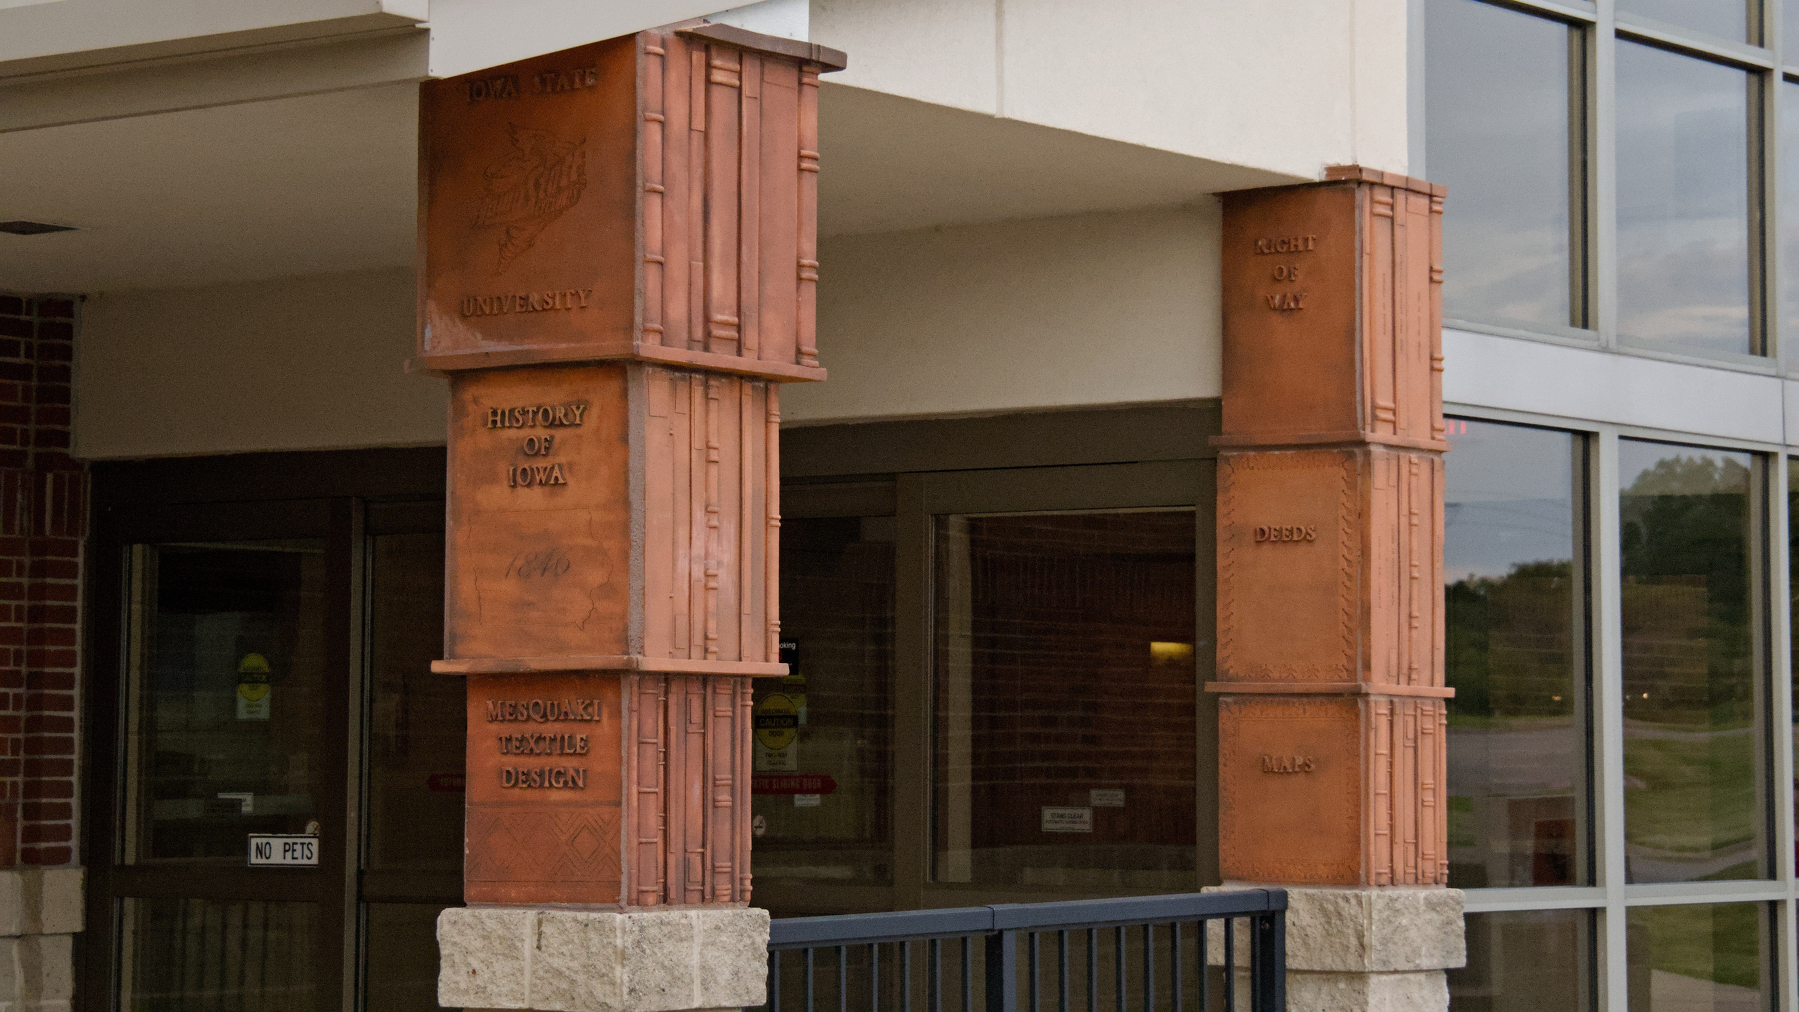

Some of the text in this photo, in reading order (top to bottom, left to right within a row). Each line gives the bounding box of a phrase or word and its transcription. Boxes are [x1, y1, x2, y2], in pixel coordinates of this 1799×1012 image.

[466, 67, 597, 103] IOWA STATE
[1254, 234, 1316, 255] RIGHT
[1273, 264, 1299, 282] OF
[462, 288, 592, 317] UNIVERSITY
[1265, 292, 1308, 312] WAY
[486, 403, 588, 429] HISTORY
[523, 434, 552, 456] OF
[507, 463, 567, 488] IOWA
[1254, 524, 1317, 543] DEEDS
[779, 641, 796, 651] oking
[486, 699, 602, 723] MESQUAKI
[759, 717, 794, 727] CAUTION
[498, 732, 590, 755] TEXTILE
[1262, 755, 1316, 774] MAPS
[500, 766, 587, 789] DESIGN
[255, 842, 314, 860] NO PETS
